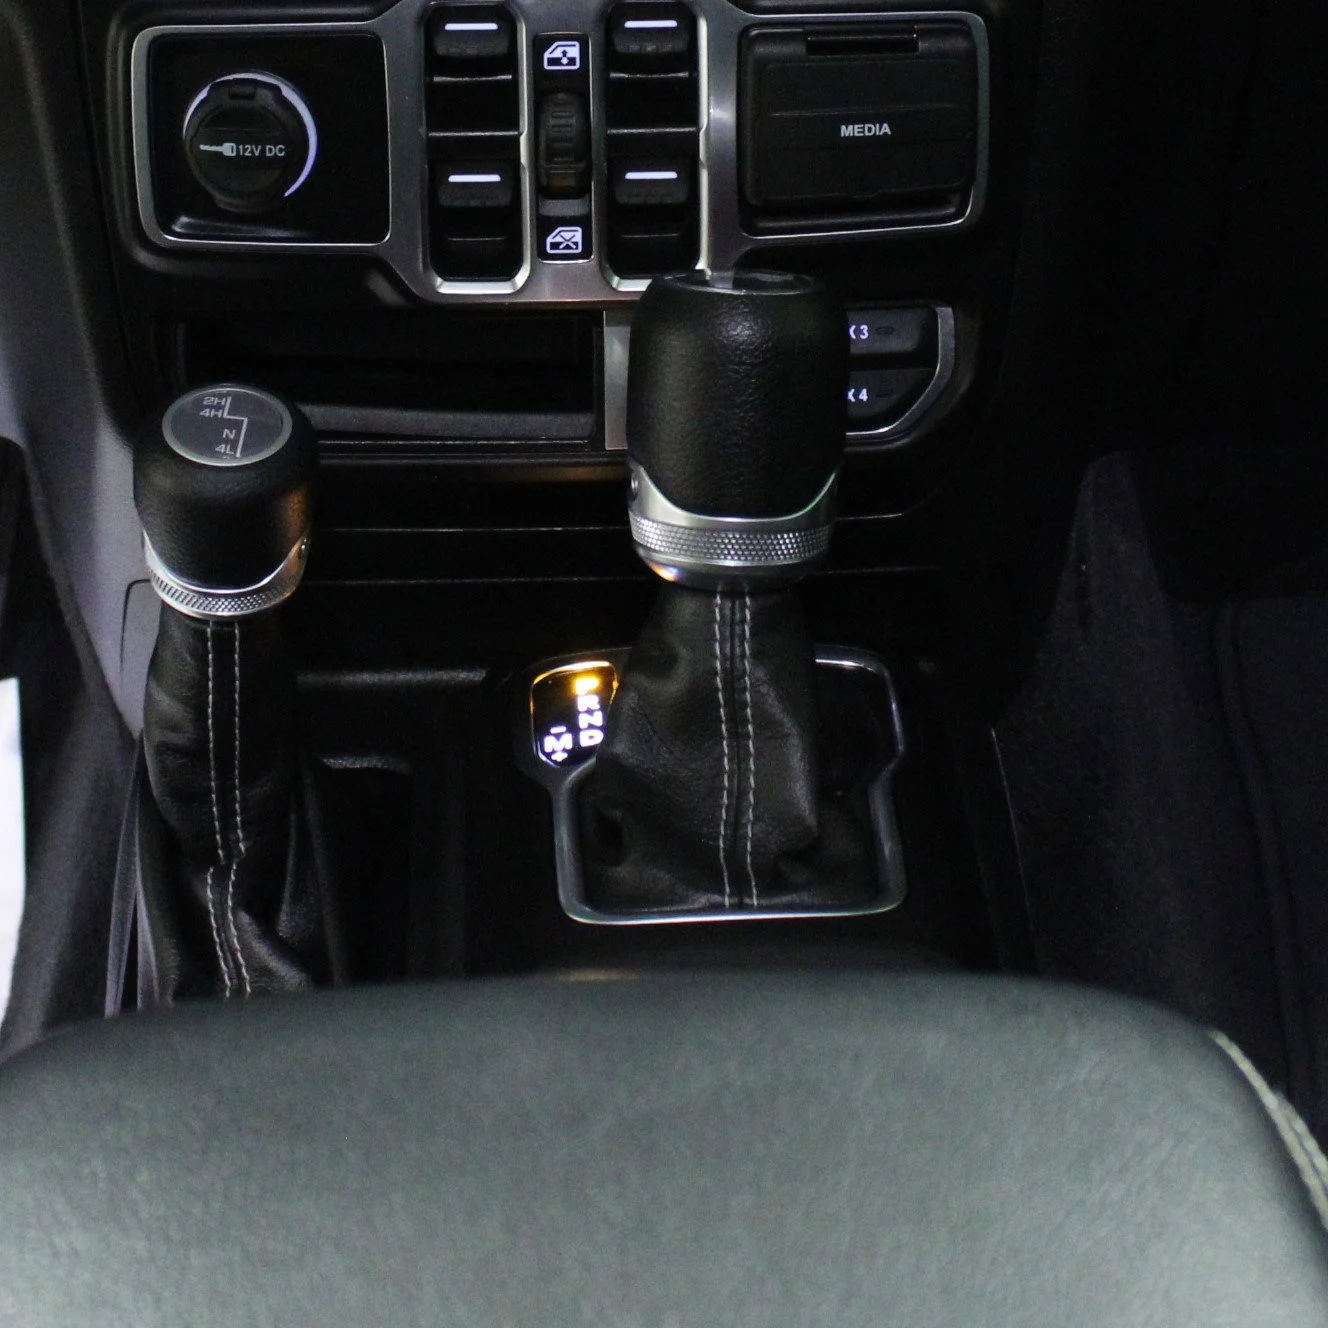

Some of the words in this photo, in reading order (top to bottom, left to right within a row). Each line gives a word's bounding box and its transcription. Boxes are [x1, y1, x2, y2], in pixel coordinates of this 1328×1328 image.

[840, 123, 892, 138] MEDIA
[238, 144, 261, 157] 12V
[266, 144, 285, 157] DC
[859, 324, 869, 339] 3
[203, 396, 226, 406] 2H
[858, 388, 869, 402] 4
[199, 408, 223, 418] 4H
[223, 428, 236, 439] N
[215, 444, 234, 455] 4L
[578, 711, 603, 729] N
[544, 732, 573, 752] M
[579, 729, 604, 747] D
